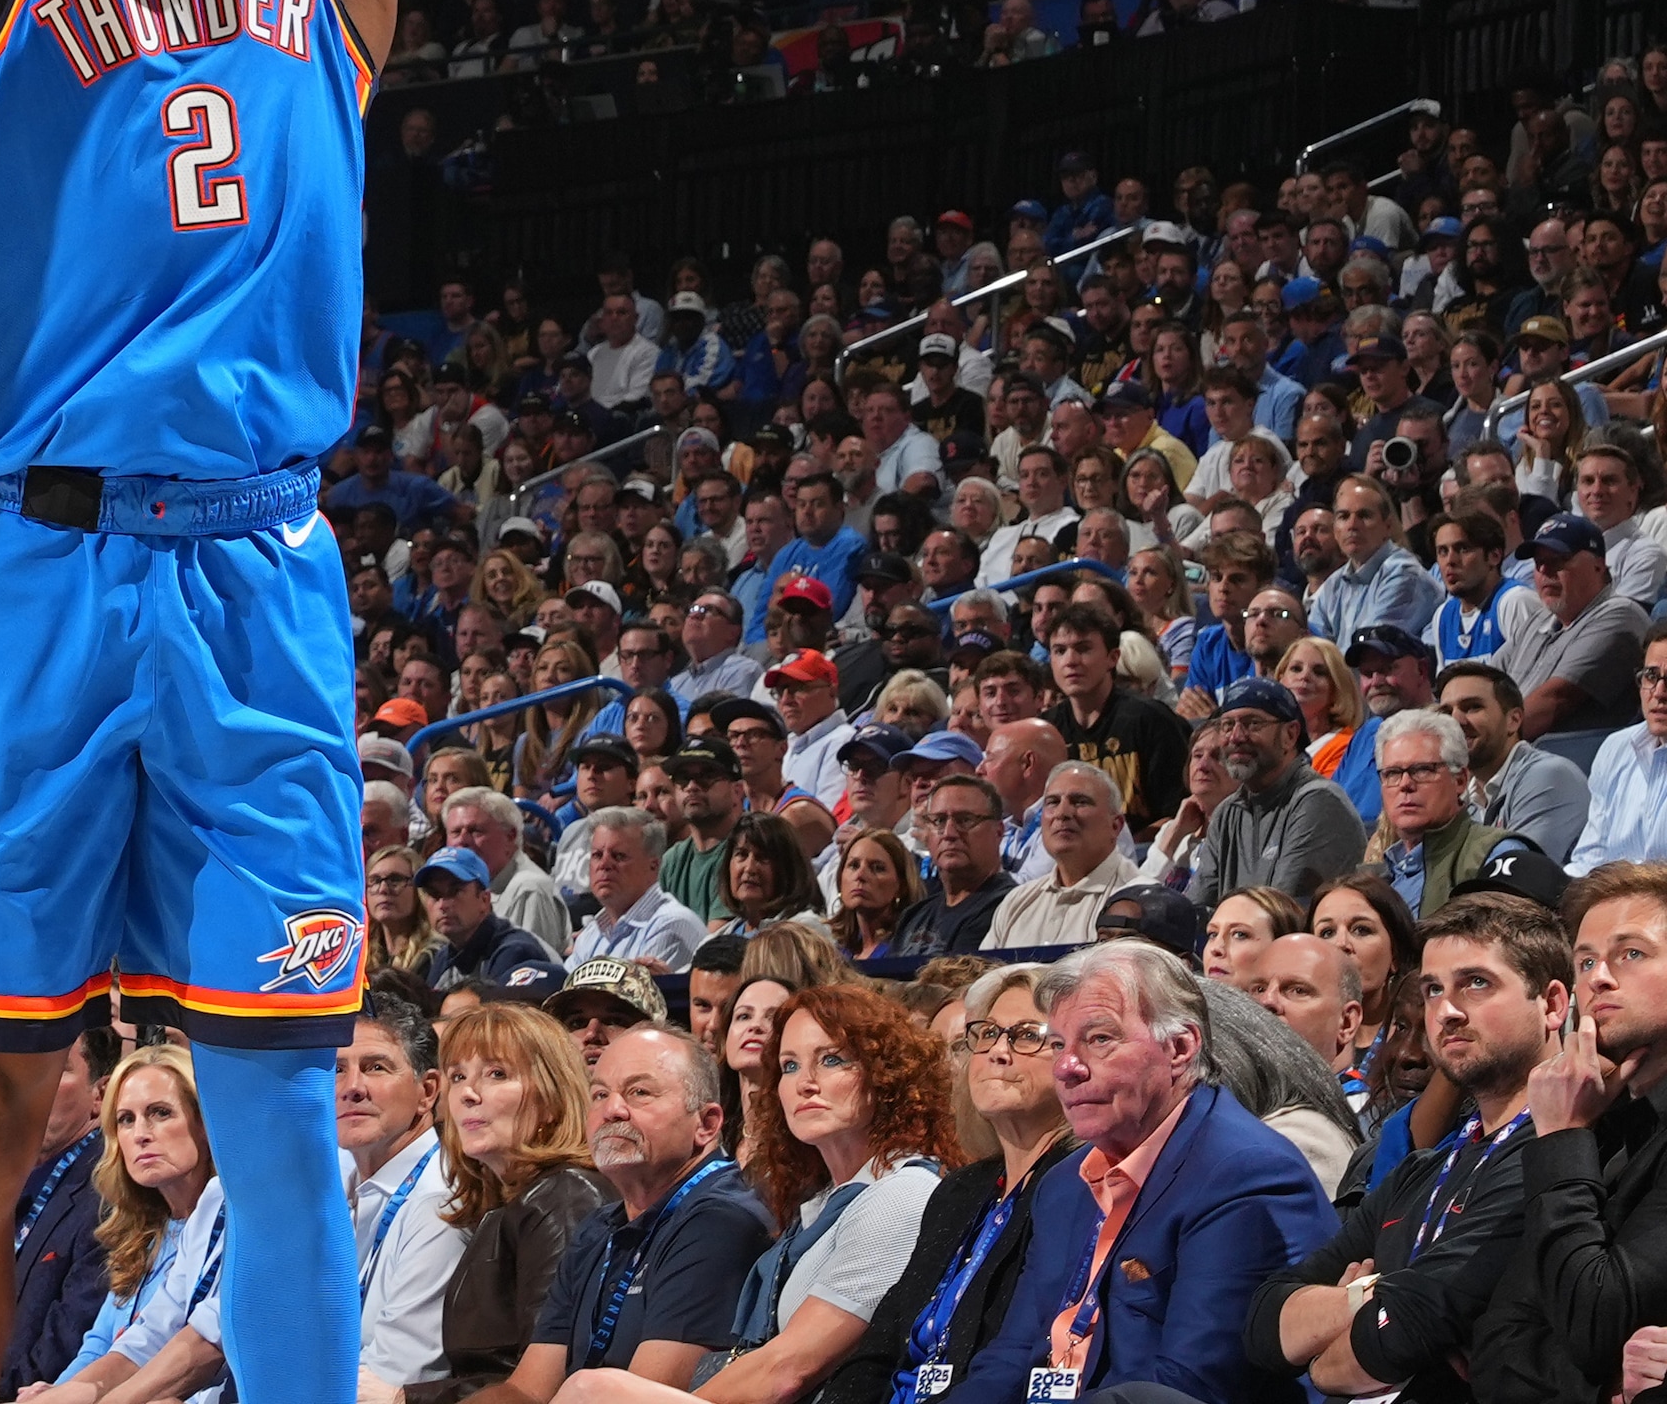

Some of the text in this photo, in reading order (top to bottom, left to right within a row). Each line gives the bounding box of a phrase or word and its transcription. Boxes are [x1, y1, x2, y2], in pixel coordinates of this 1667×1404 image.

[160, 83, 250, 233] 2
[286, 926, 346, 972] OKC
[593, 1269, 634, 1349] THUNDER
[919, 1368, 950, 1383] 2025
[1032, 1372, 1075, 1386] 2025
